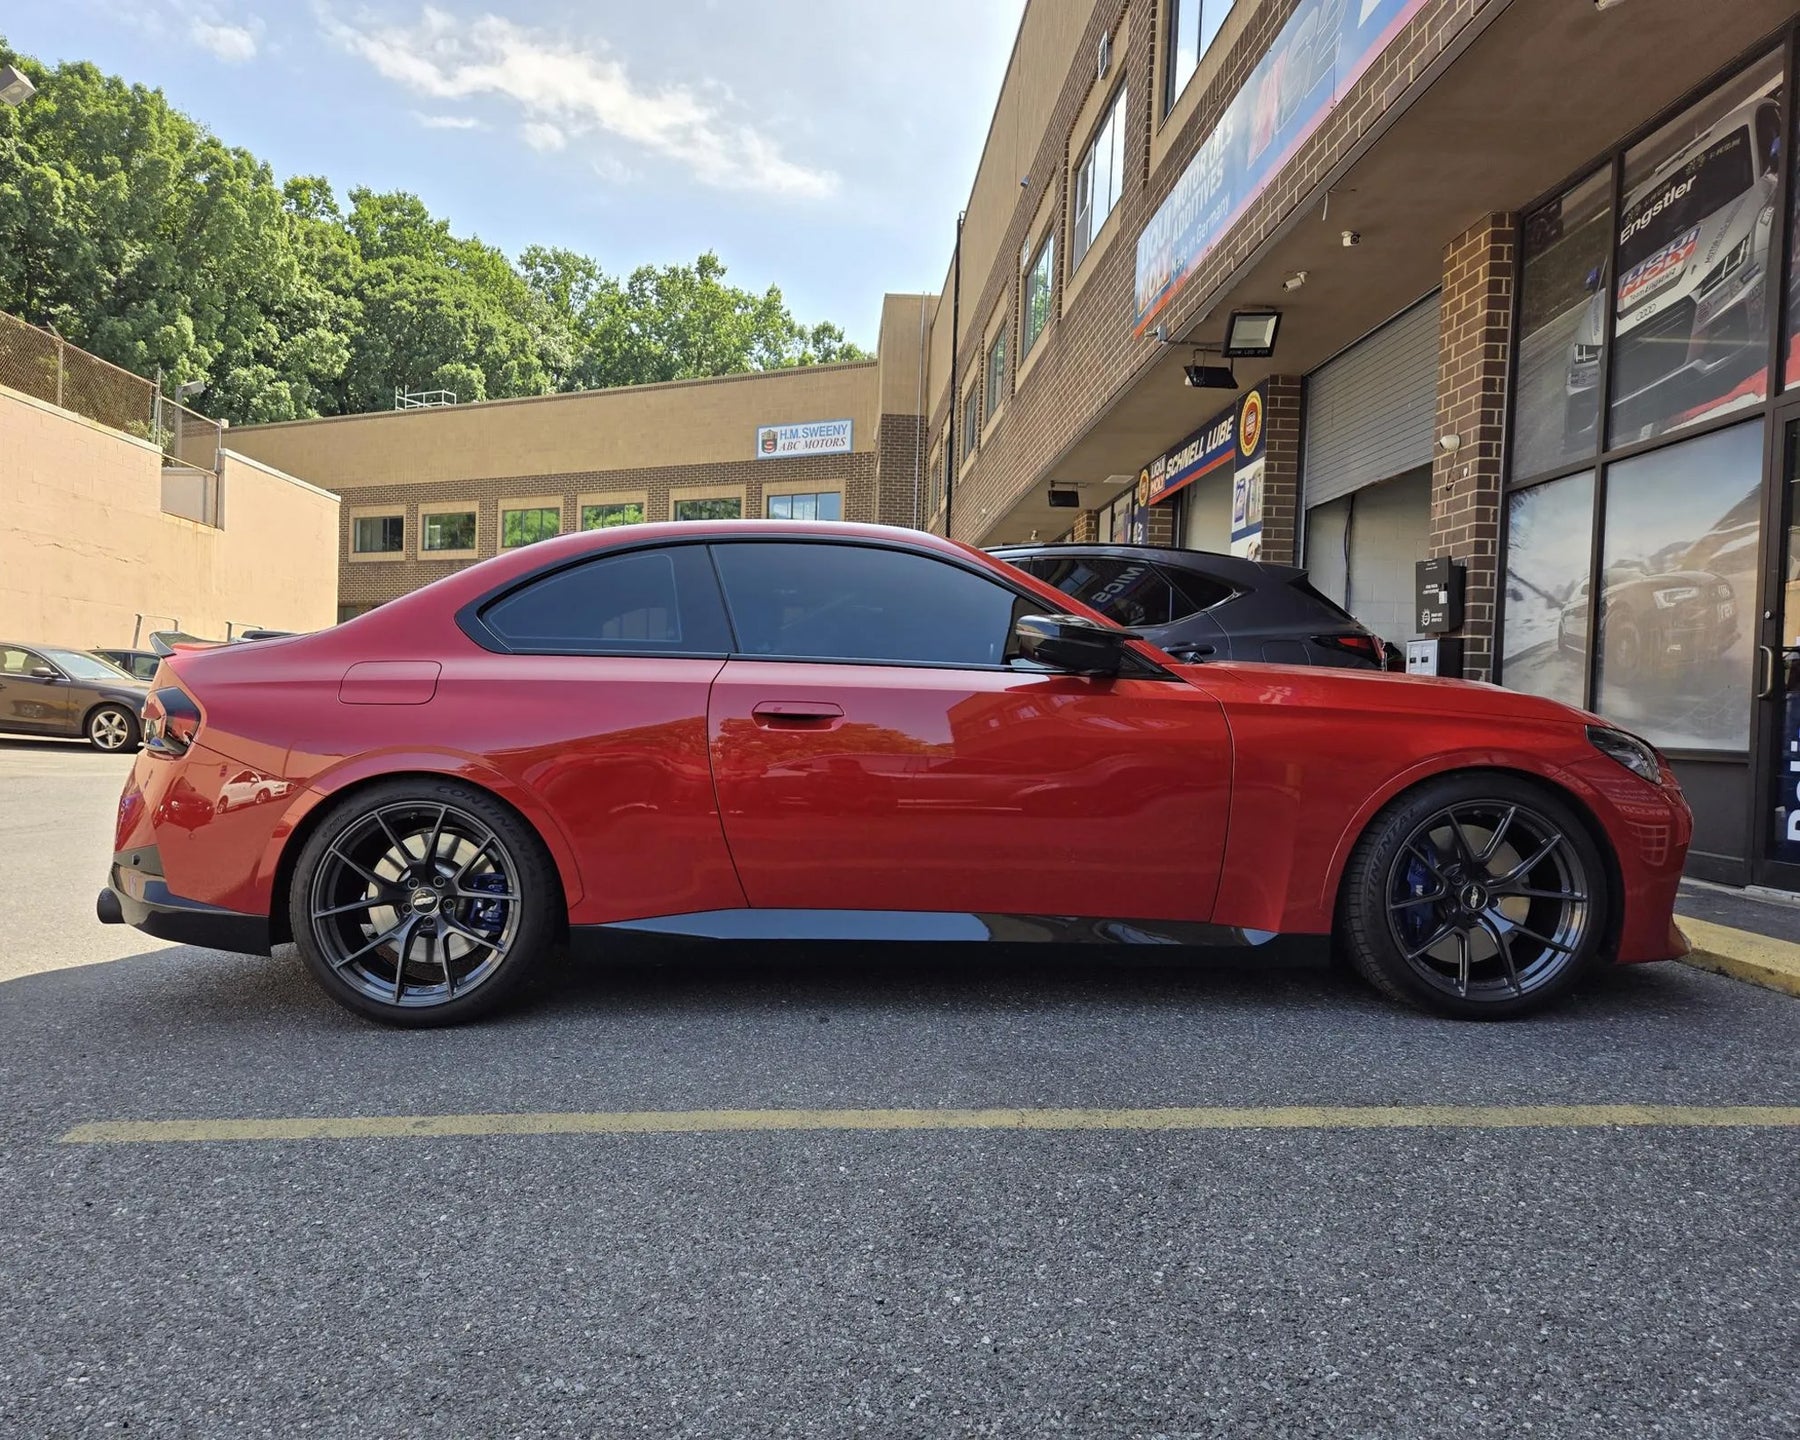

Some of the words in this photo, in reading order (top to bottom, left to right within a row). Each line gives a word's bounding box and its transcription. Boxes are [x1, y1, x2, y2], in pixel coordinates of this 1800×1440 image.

[1172, 158, 1206, 208] MOTOR
[1172, 158, 1223, 245] ADDITIVES
[1620, 175, 1697, 245] Engstler
[1196, 192, 1229, 243] Germany
[1621, 242, 1697, 297] MOLY
[1623, 229, 1699, 285] LIQUI
[779, 441, 801, 451] ABC
[803, 437, 846, 449] MOTORS
[802, 424, 848, 438] SWEENY
[1166, 435, 1205, 480] SCHNELL
[1206, 415, 1235, 454] LUBE
